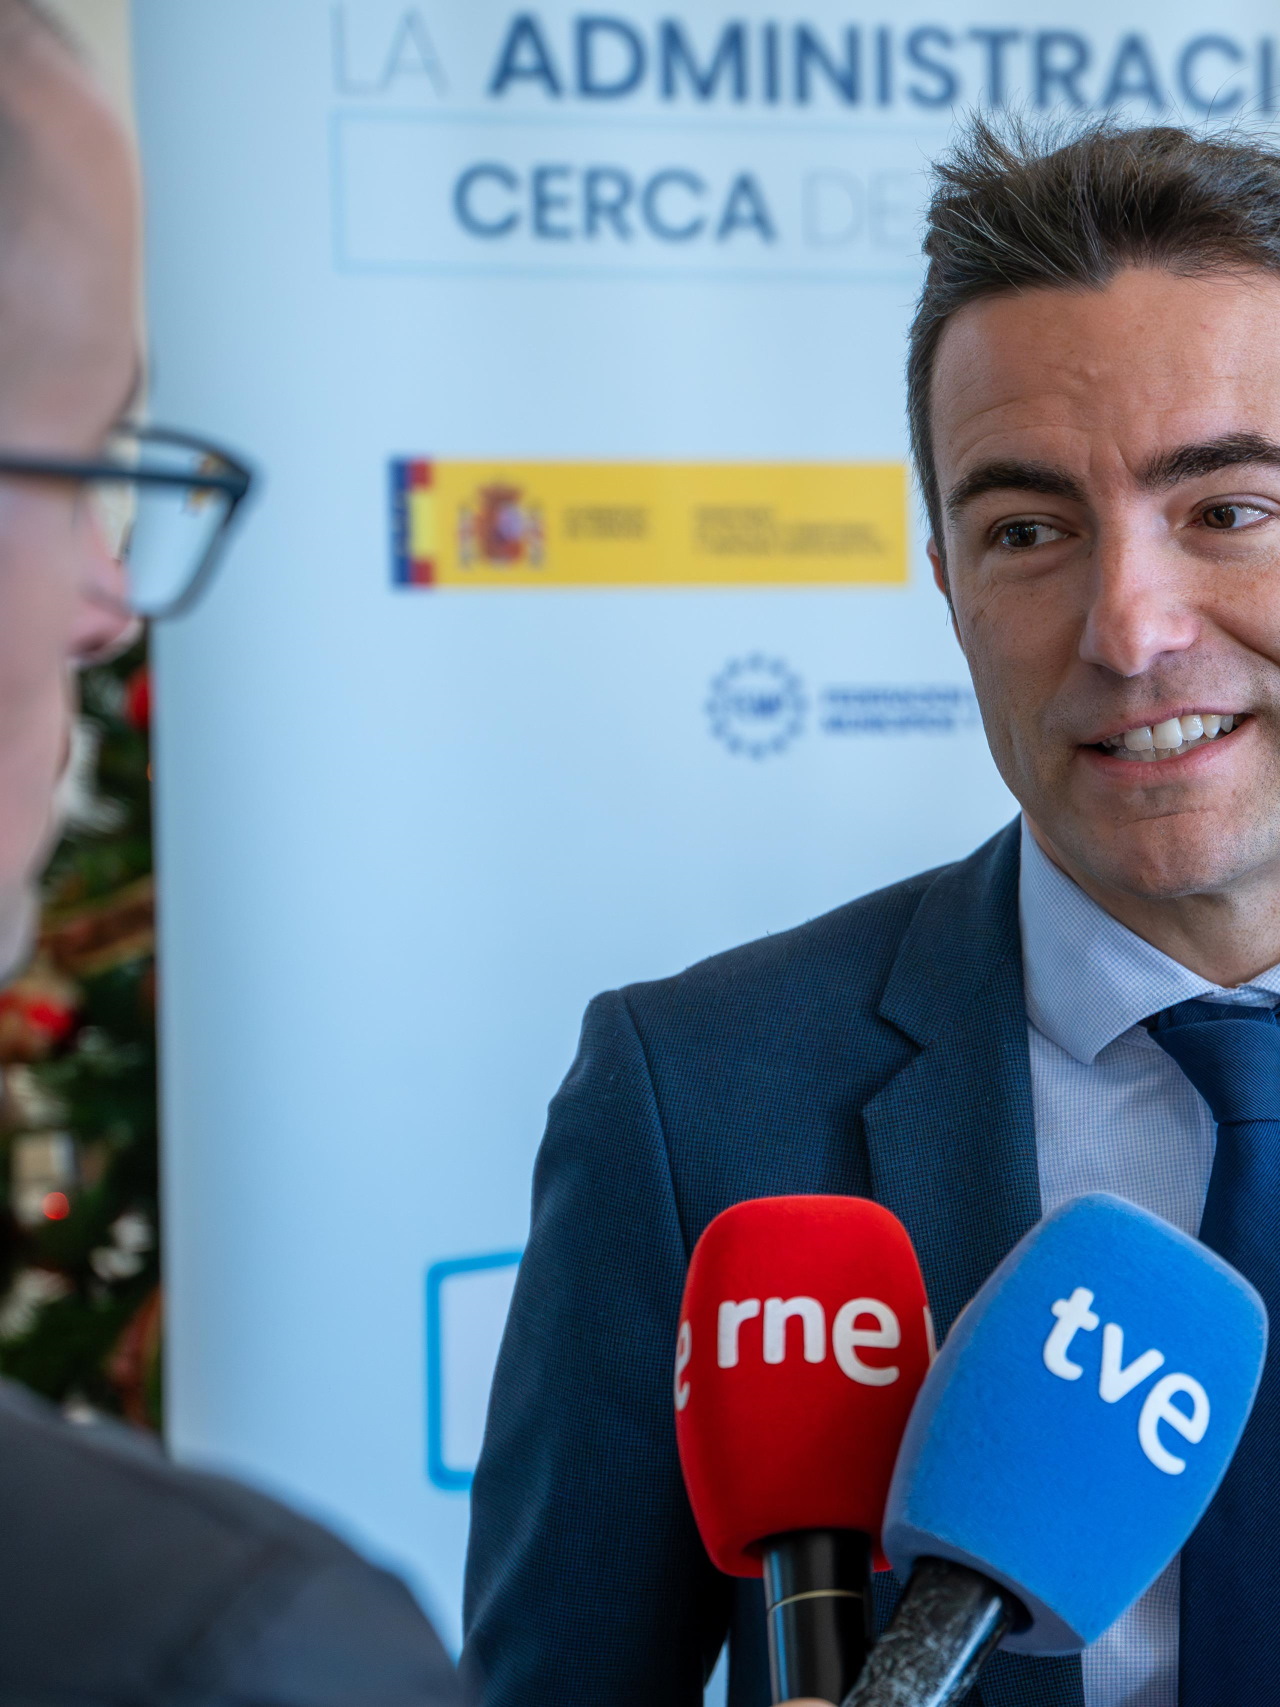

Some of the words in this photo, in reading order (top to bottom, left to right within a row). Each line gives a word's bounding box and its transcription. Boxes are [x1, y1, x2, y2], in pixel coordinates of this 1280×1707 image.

[331, 8, 450, 98] LA
[451, 161, 779, 246] CERCA
[717, 1296, 901, 1387] rne
[1043, 1286, 1211, 1476] tve
